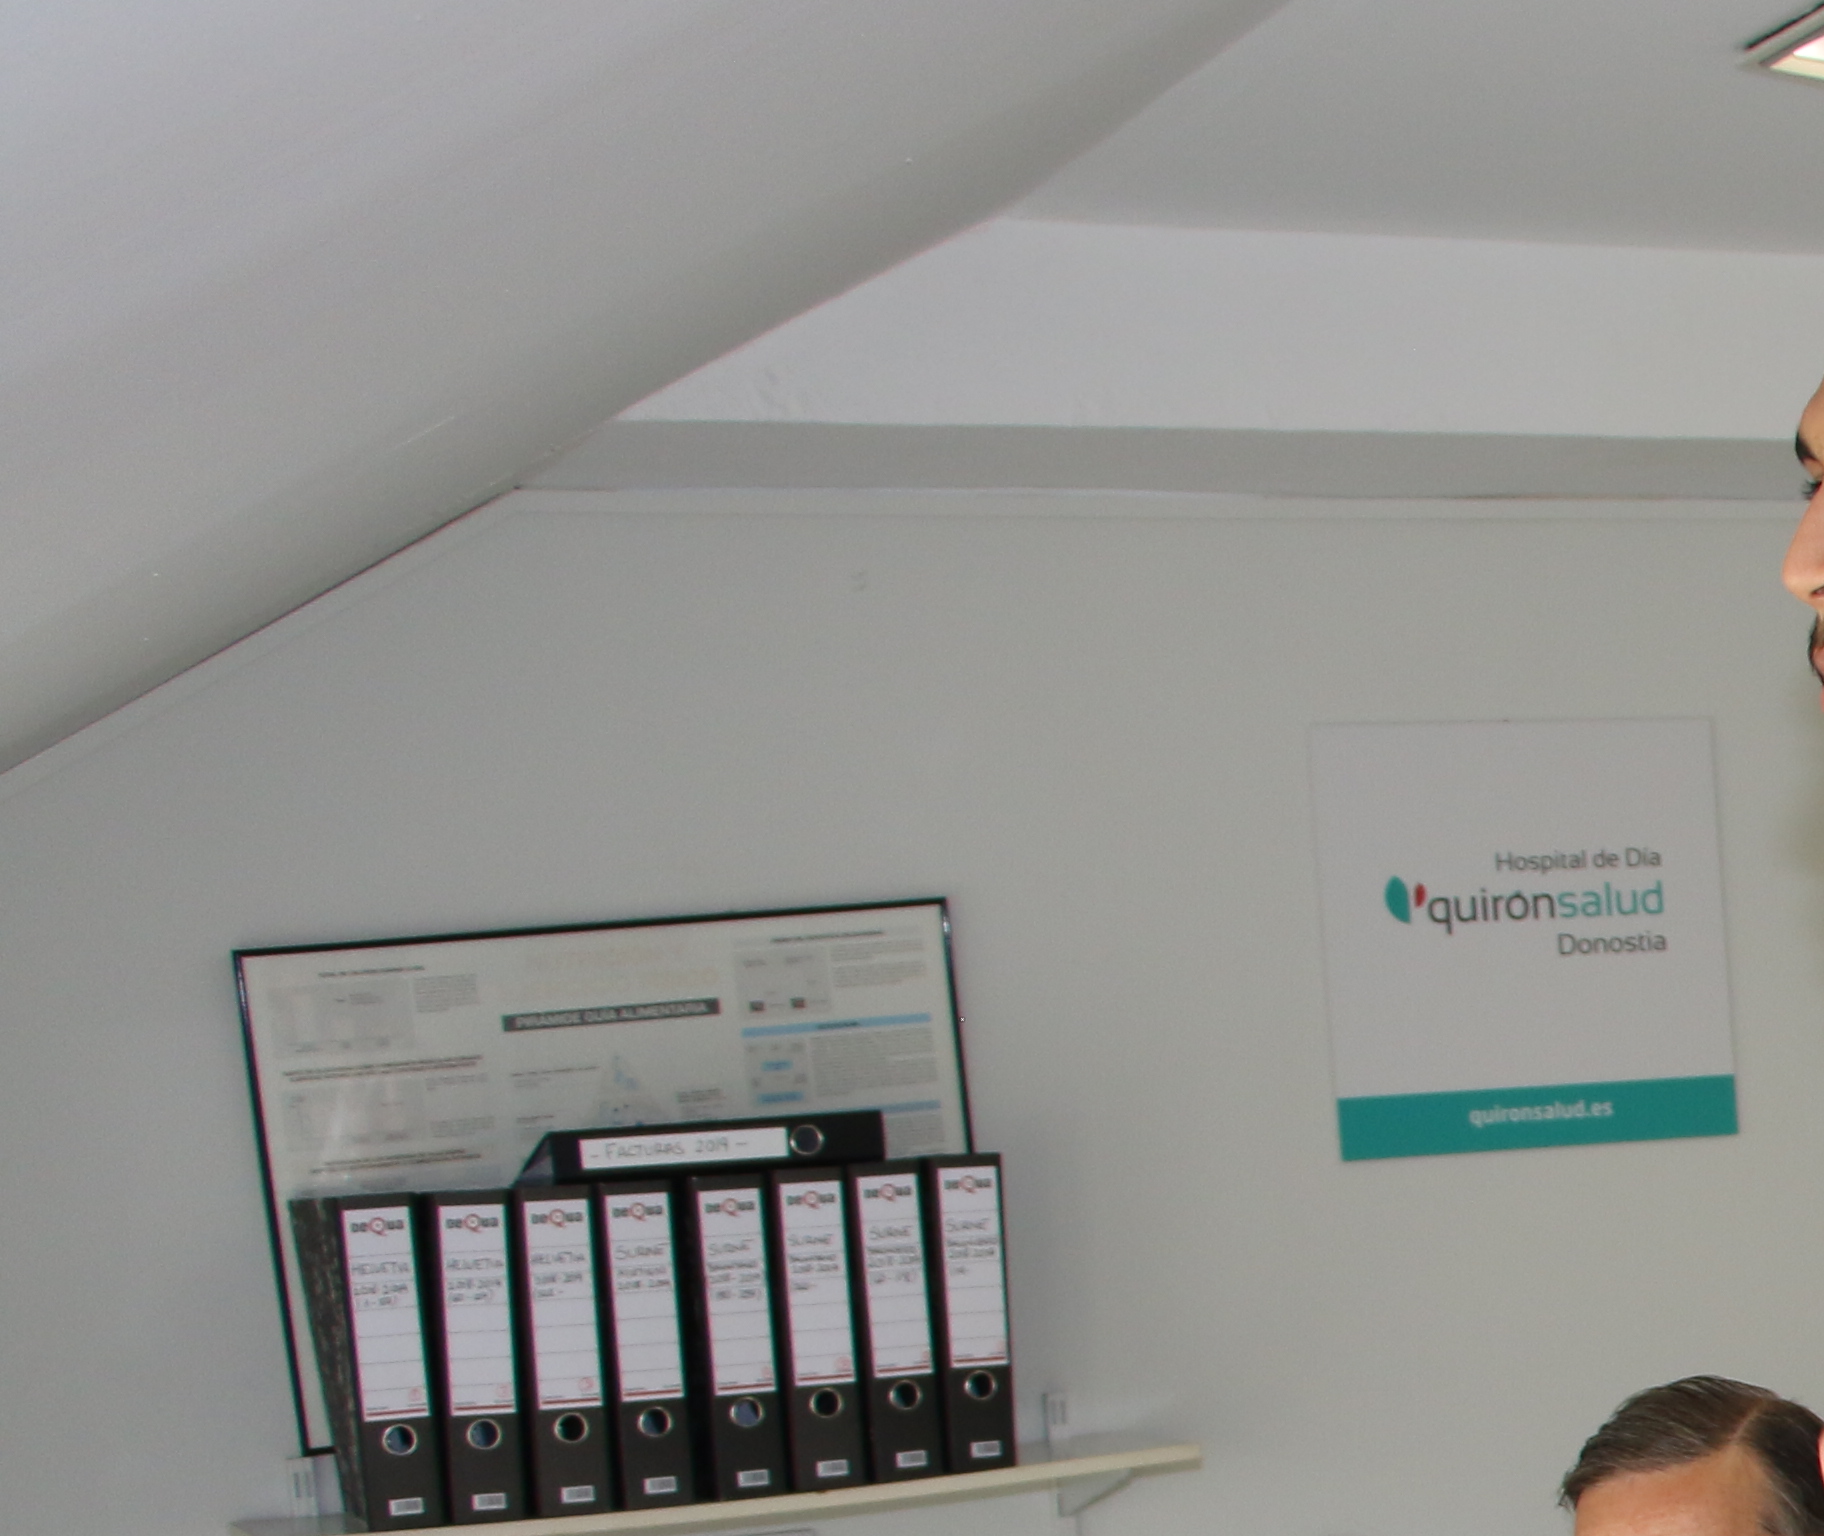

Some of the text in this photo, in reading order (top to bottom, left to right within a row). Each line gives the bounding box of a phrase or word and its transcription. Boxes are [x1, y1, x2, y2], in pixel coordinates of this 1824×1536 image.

[1494, 847, 1663, 874] Hospital de Día
[1557, 931, 1668, 956] Donostia
[1468, 1101, 1614, 1128] quironsalud.es
[695, 1136, 730, 1154] 2019
